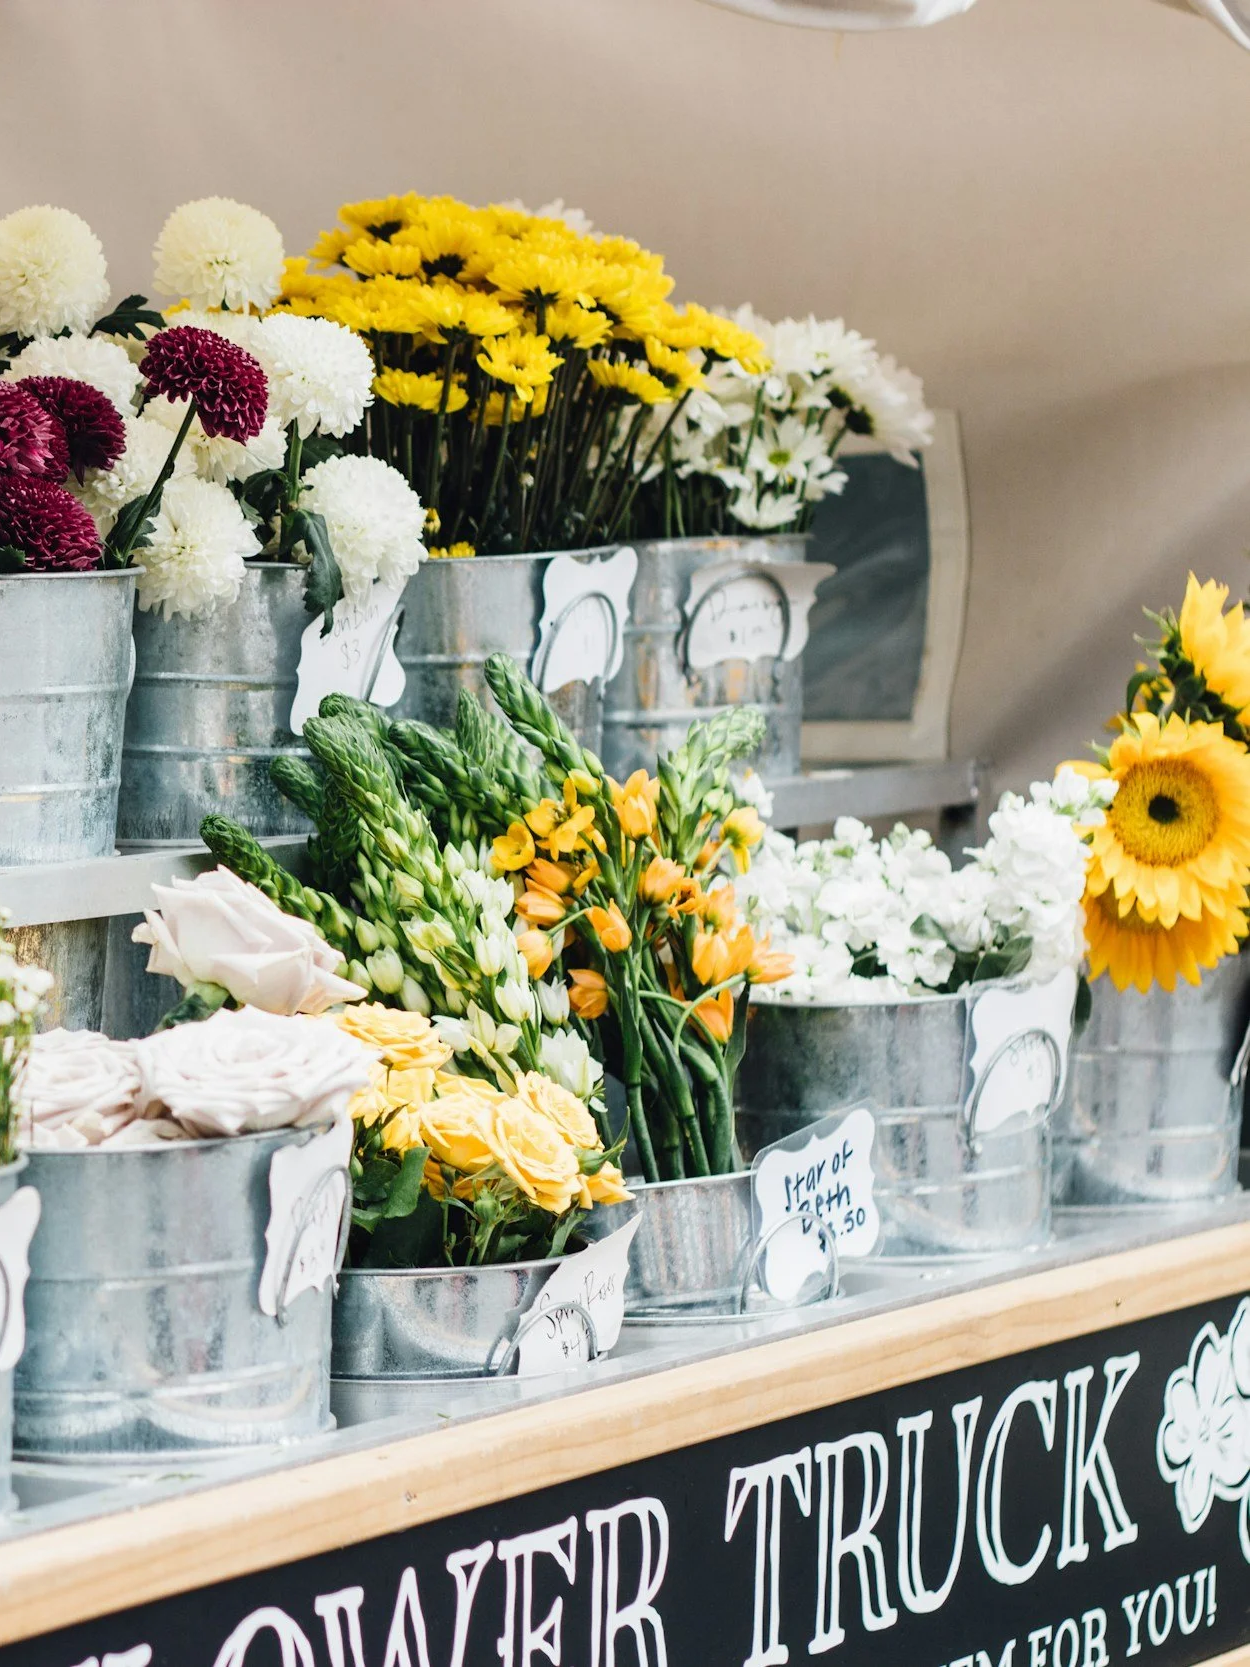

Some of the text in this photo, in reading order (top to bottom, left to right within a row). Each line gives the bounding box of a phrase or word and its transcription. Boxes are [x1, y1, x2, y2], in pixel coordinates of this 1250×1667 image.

[784, 1138, 854, 1213] Star of
[798, 1180, 851, 1235] Beth
[723, 1350, 1141, 1667] TRUCK
[1027, 1564, 1218, 1667] FOR YOU!
